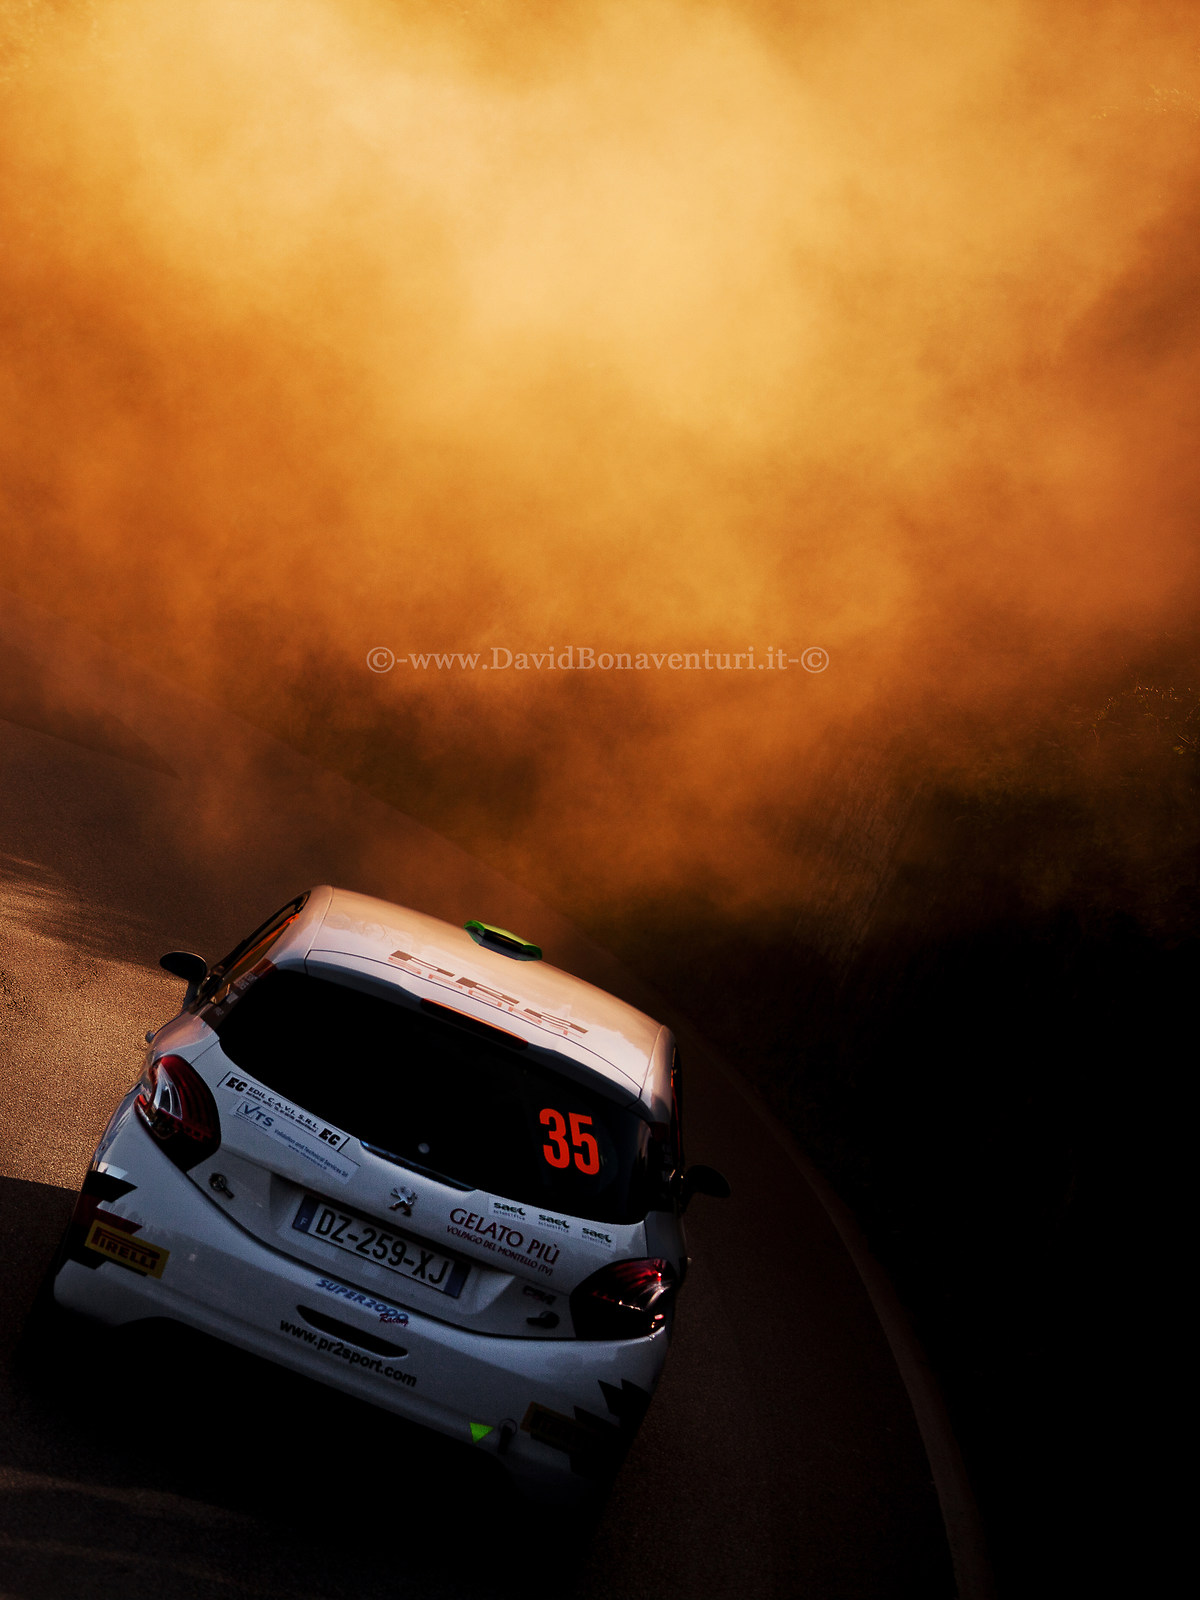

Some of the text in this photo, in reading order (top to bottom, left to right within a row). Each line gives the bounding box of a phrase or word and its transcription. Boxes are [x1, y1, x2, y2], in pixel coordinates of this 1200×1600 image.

[226, 1077, 248, 1092] EC
[248, 1087, 266, 1099] EDIL
[318, 1128, 341, 1146] EC
[244, 1103, 274, 1127] VTS
[539, 1108, 600, 1176] 35
[91, 1226, 161, 1270] PIRELLI
[316, 1208, 450, 1285] DZ-259-XJ
[447, 1225, 483, 1245] VOLPAGO
[483, 1239, 496, 1252] DEL
[497, 1246, 538, 1269] MONTELLO
[449, 1208, 524, 1247] GELATO
[527, 1239, 560, 1265] PIÙ
[280, 1320, 418, 1387] www.pr2sport.com
